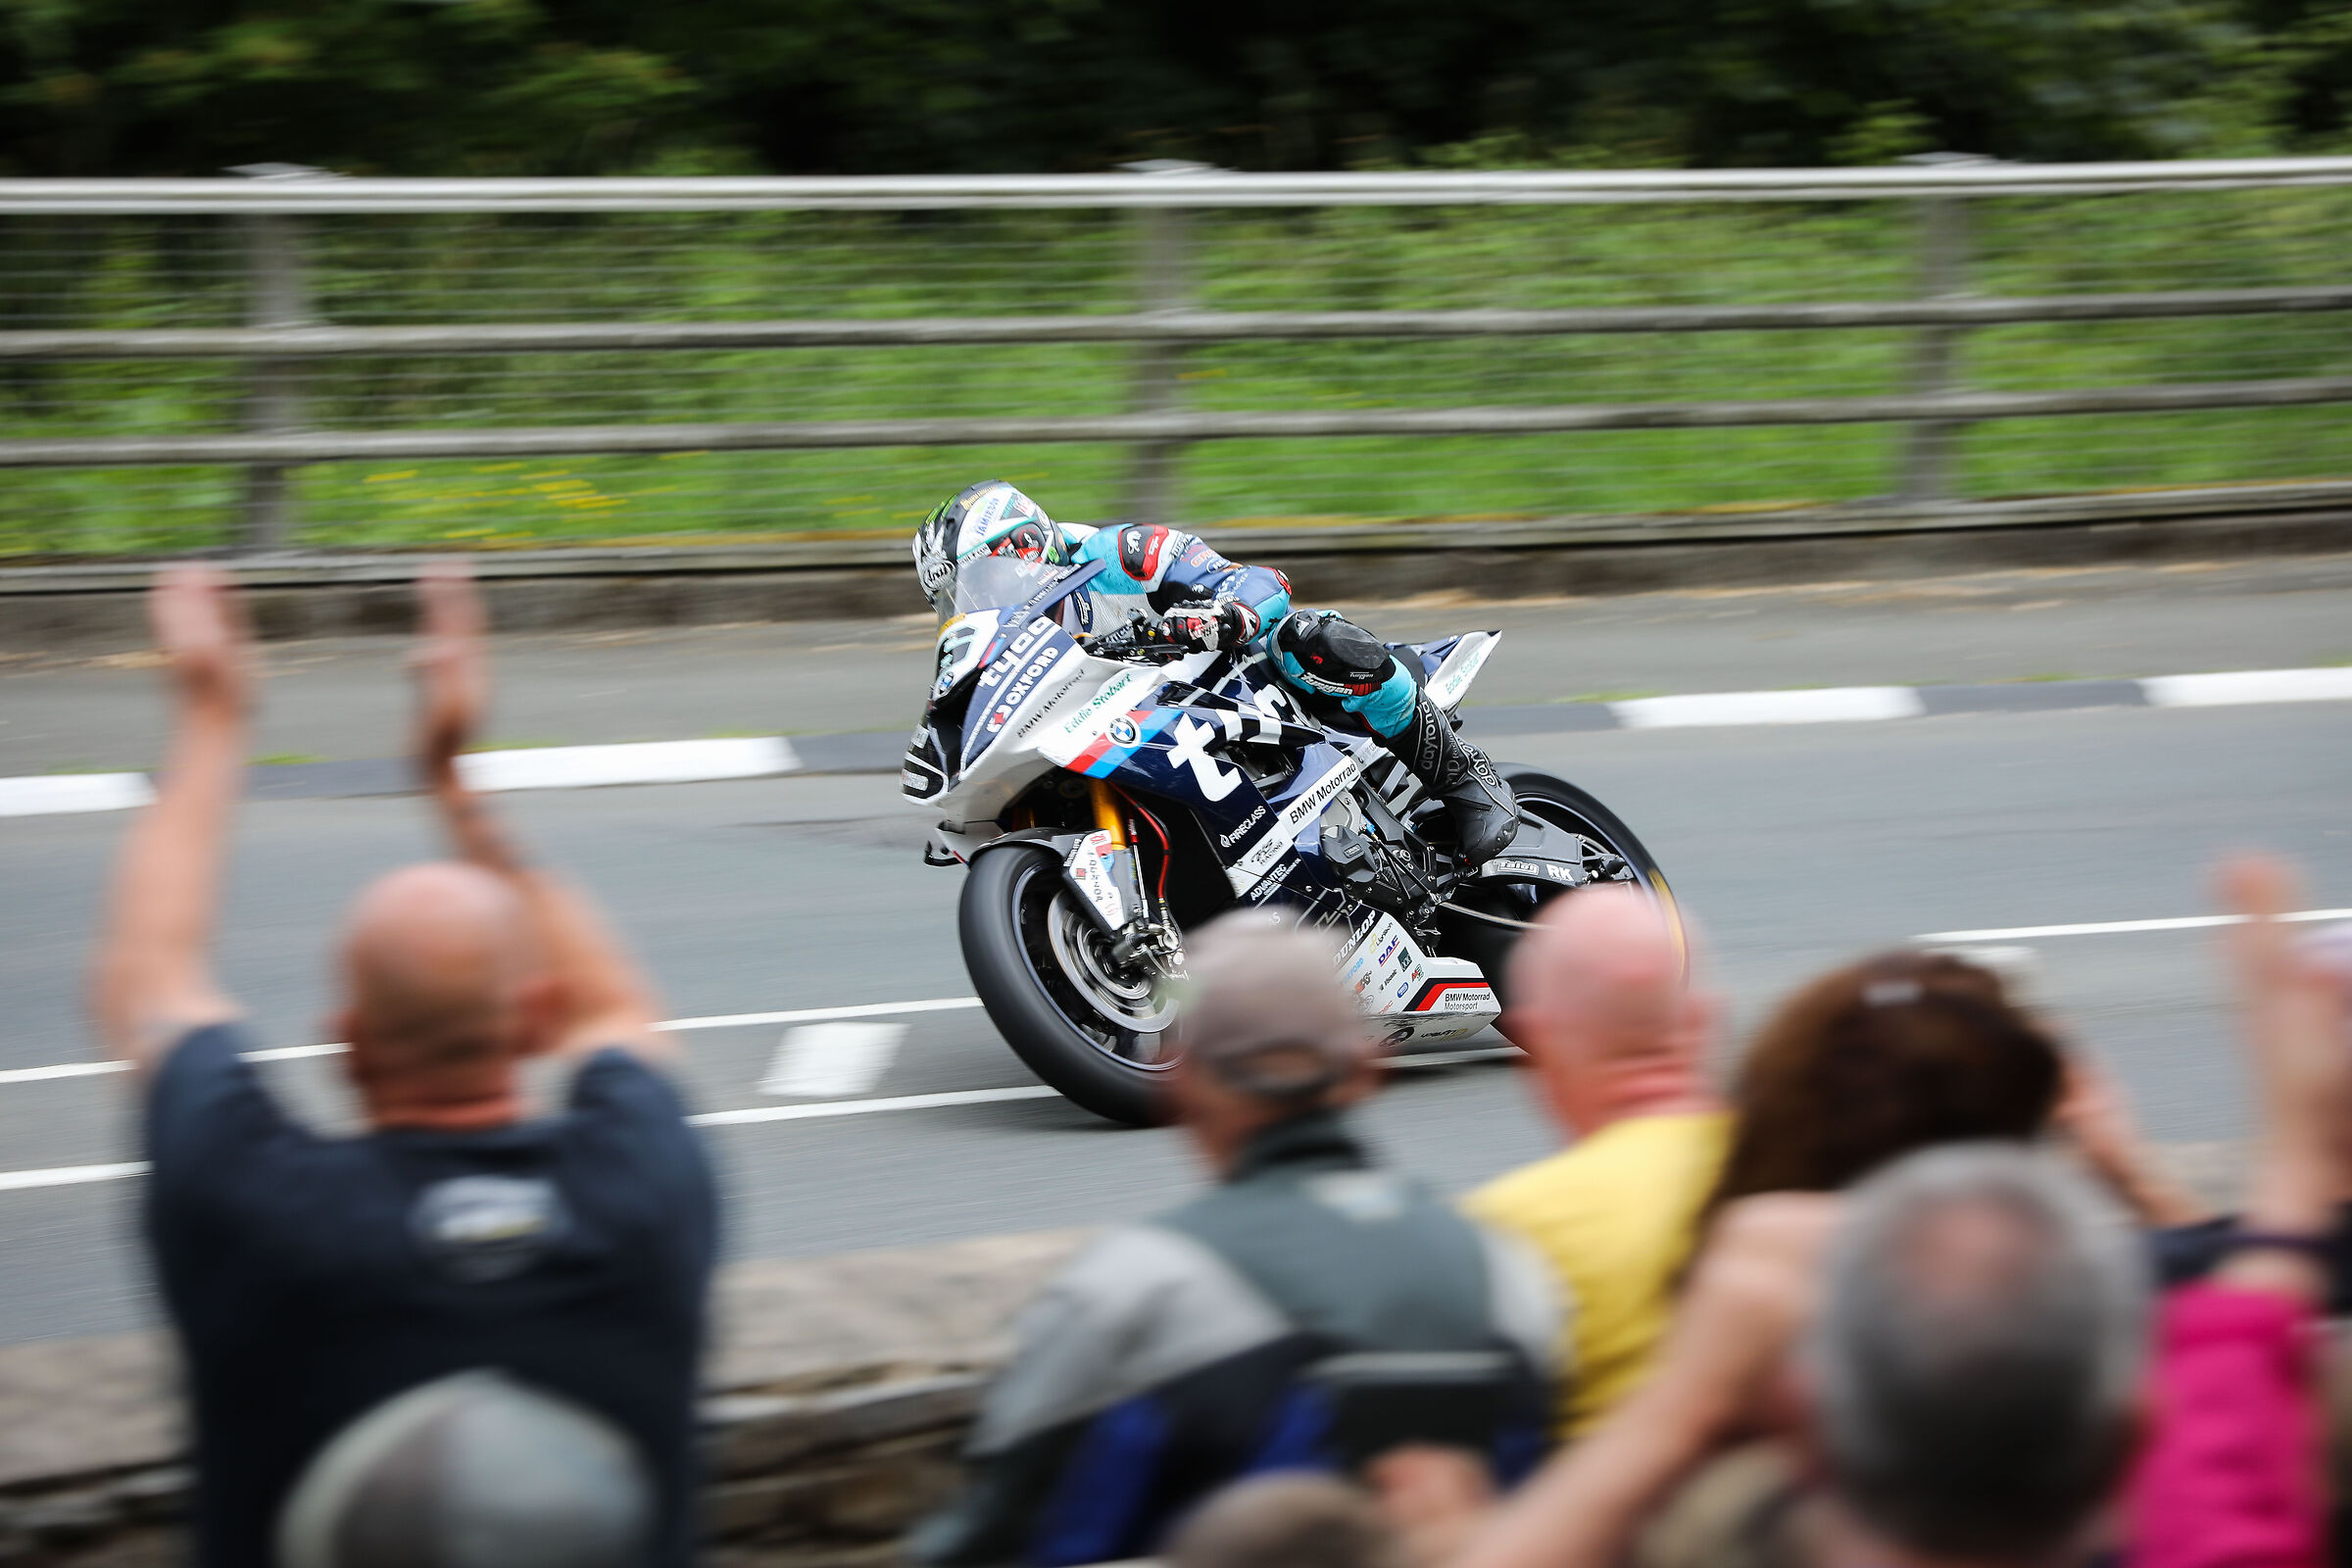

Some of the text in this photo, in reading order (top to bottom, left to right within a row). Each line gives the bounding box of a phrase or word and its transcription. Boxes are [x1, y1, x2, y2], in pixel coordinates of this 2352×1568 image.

[1004, 647, 1059, 705] OXFORD
[1016, 668, 1085, 738] BMW Motorrad
[1063, 673, 1136, 734] Eddie Stobart
[1421, 701, 1439, 770] daytona
[1289, 762, 1357, 825] BMW Motorrad
[1250, 863, 1288, 901] ADVANTEC
[1545, 863, 1574, 882] RK
[1332, 909, 1376, 966] DUNLOP
[1378, 934, 1399, 964] DAF
[1444, 1003, 1478, 1011] Motorsport
[1445, 992, 1491, 1003] BMW Motorrad
